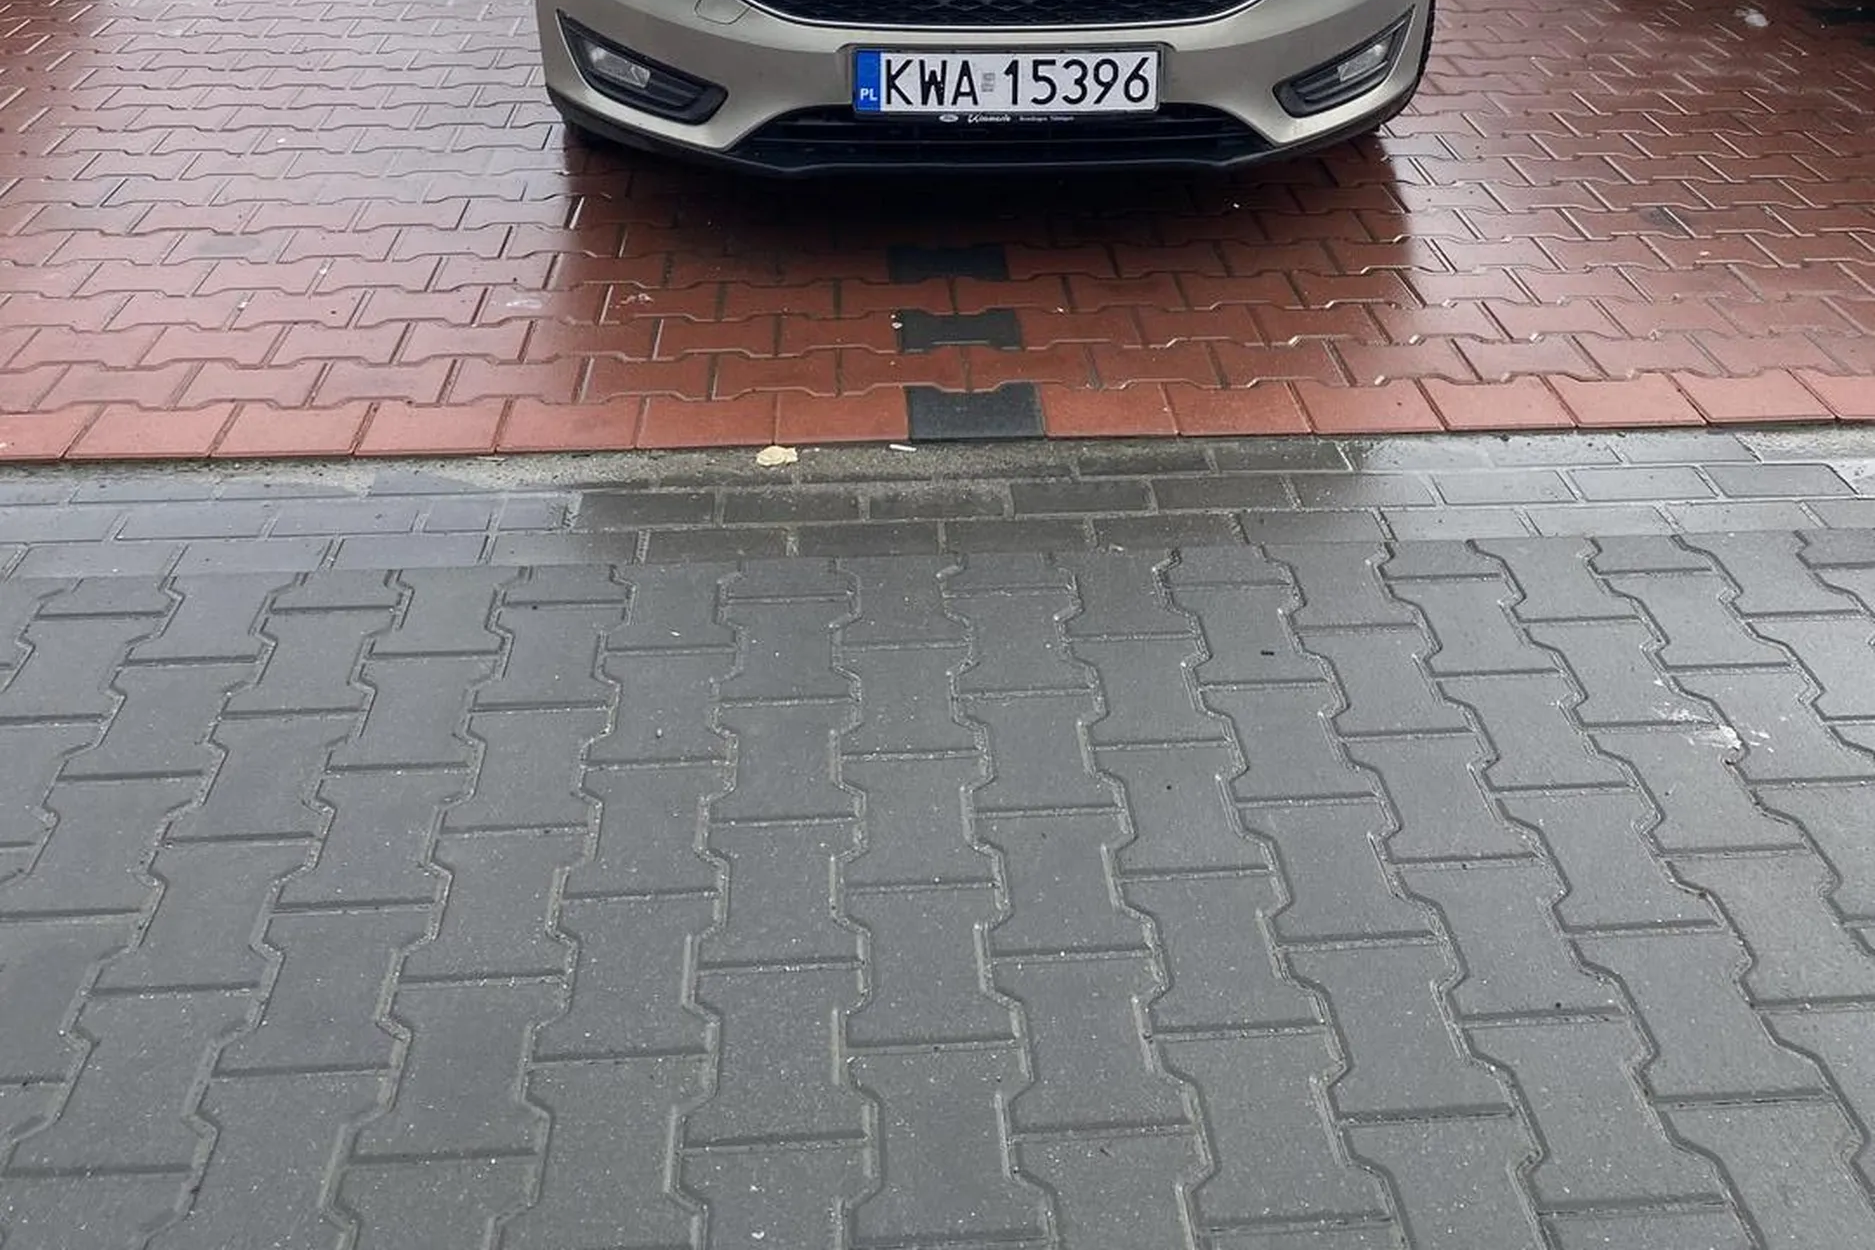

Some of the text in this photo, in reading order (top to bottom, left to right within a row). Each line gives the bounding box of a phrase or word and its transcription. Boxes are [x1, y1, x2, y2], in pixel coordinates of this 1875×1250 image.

[860, 88, 878, 101] PL
[885, 56, 1150, 106] KWA 15396
